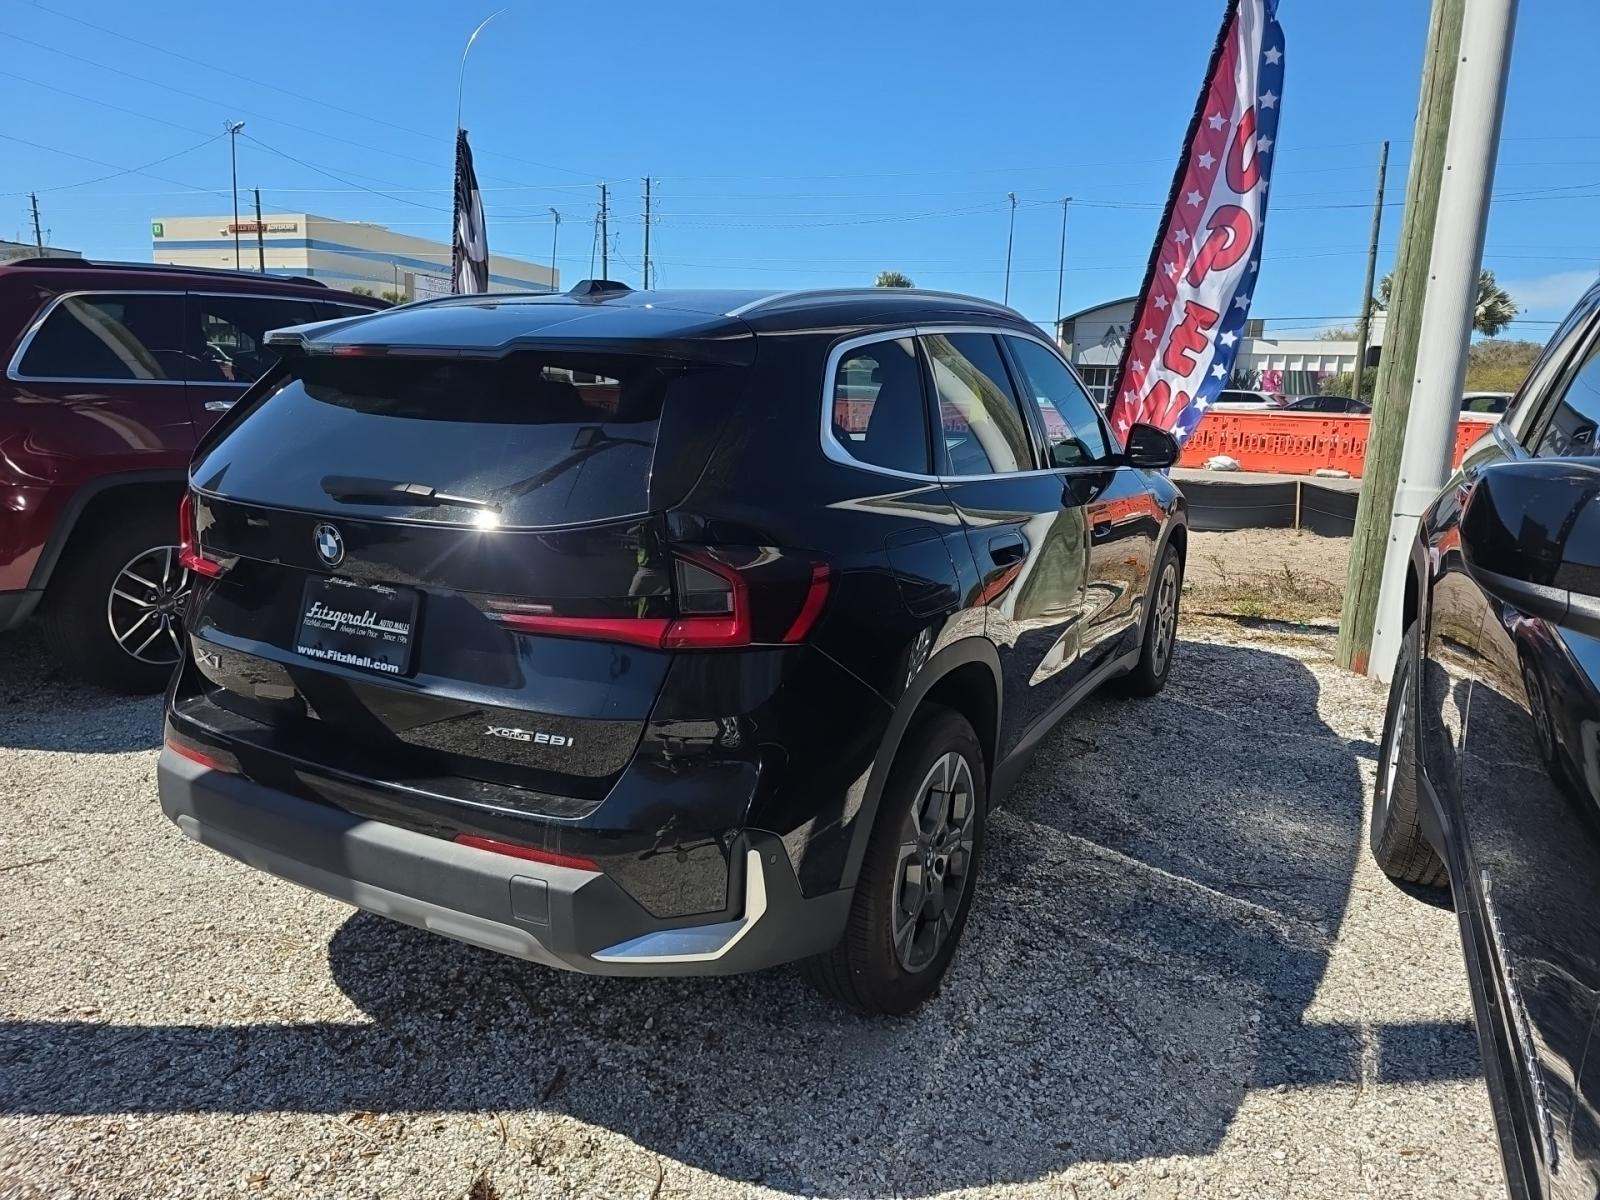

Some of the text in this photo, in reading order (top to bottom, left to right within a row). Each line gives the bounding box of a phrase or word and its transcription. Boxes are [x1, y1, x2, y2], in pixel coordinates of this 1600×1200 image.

[305, 601, 377, 631] Fitzgerald
[340, 624, 356, 636] Always
[356, 627, 367, 636] Low
[383, 632, 397, 642] Since
[195, 648, 219, 669] X1
[297, 644, 399, 673] www.FitzMall.com
